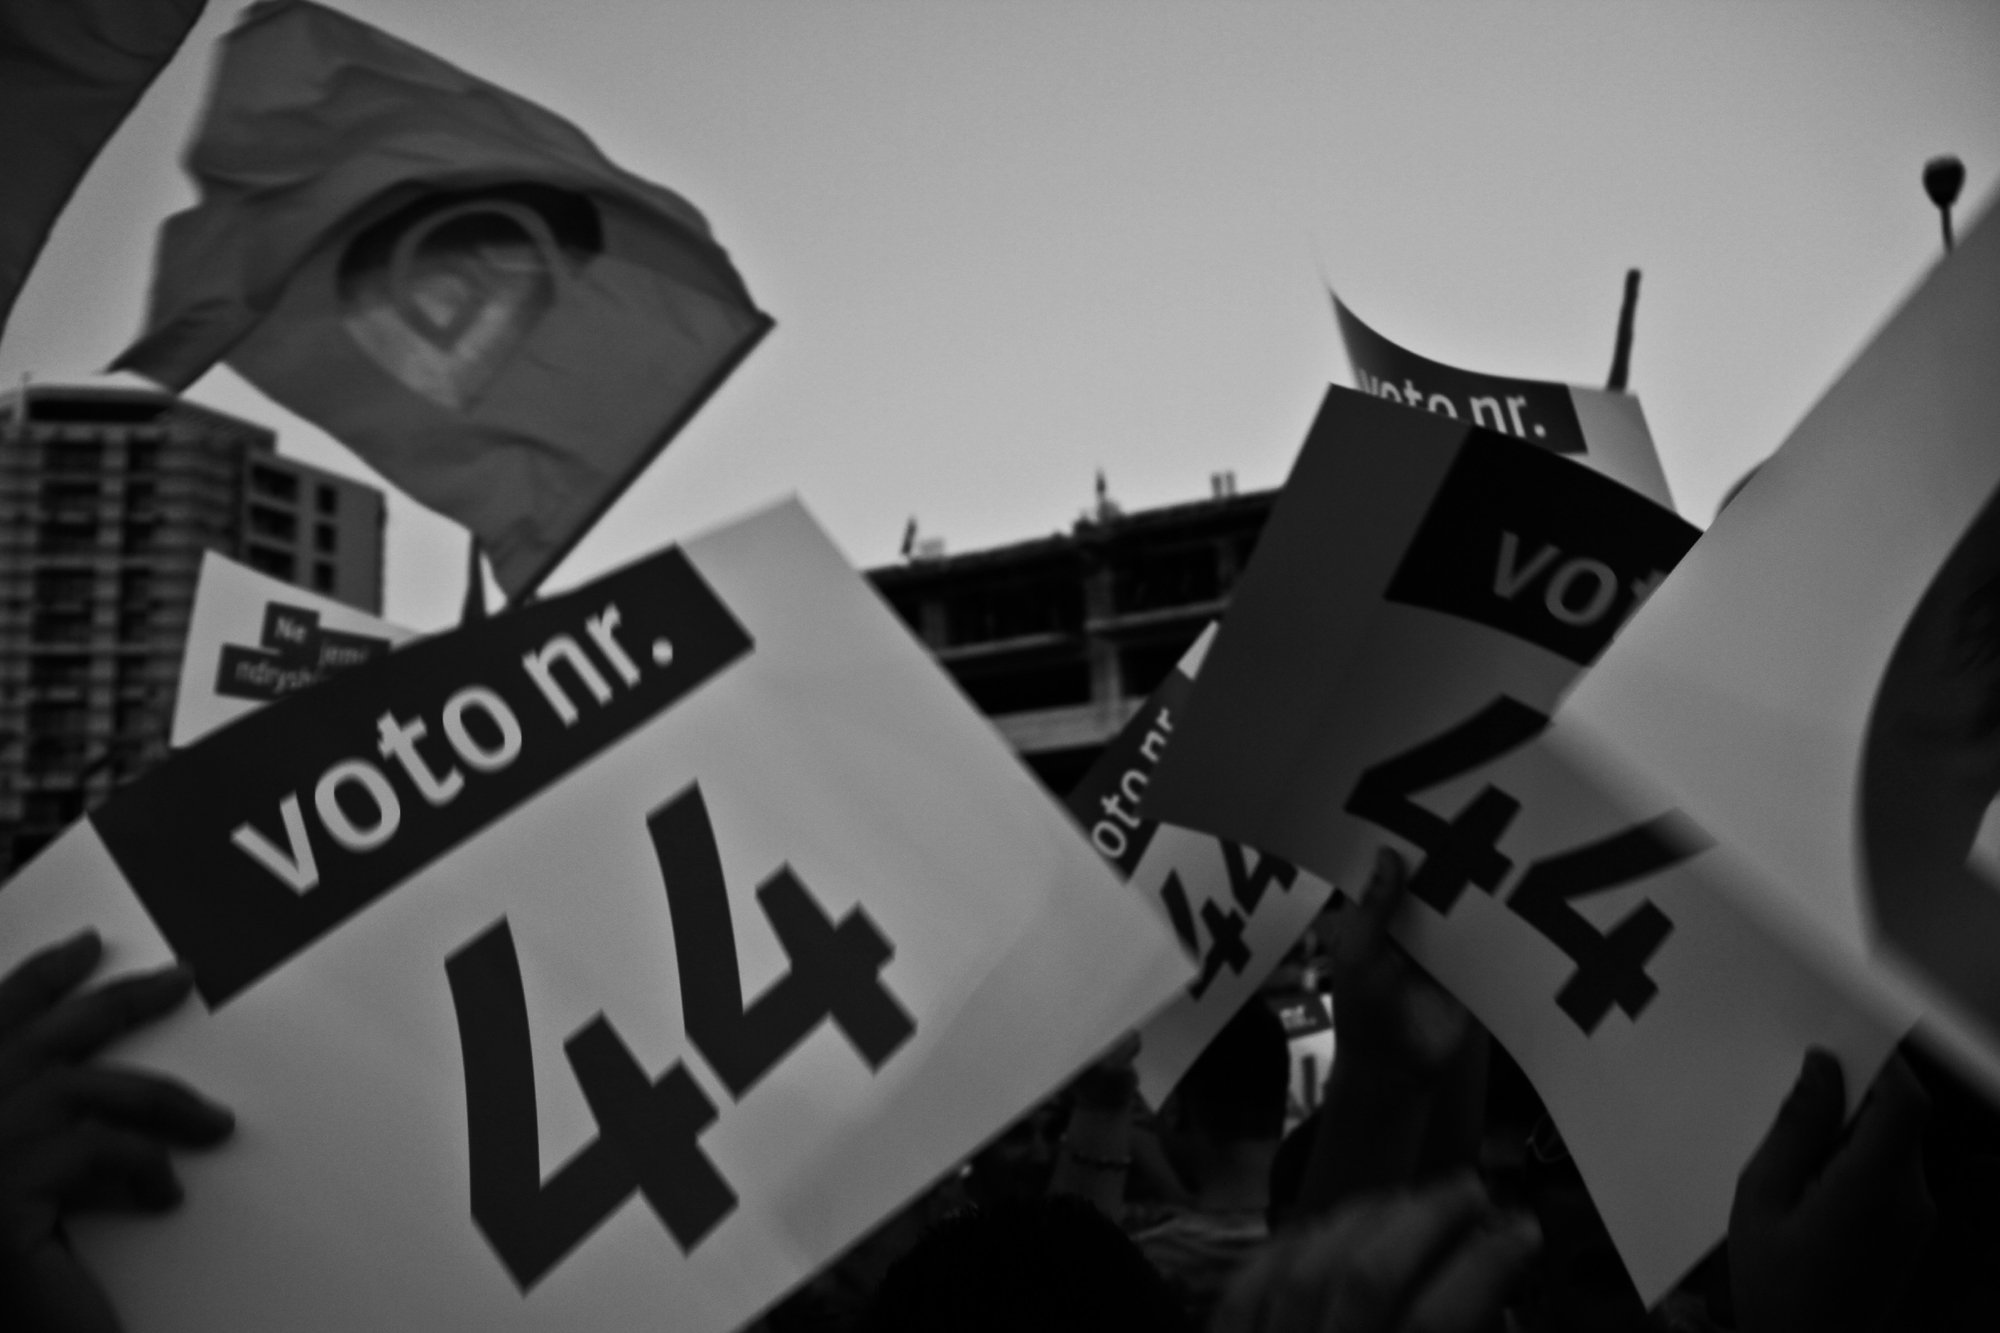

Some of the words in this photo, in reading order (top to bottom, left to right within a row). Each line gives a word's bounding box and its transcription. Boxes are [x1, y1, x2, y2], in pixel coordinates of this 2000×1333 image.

[1469, 395, 1548, 438] nr.
[230, 683, 523, 897] voto
[522, 601, 674, 729] nr.
[273, 614, 308, 645] Ne
[1343, 693, 1720, 1038] 44
[444, 777, 917, 1298] 44
